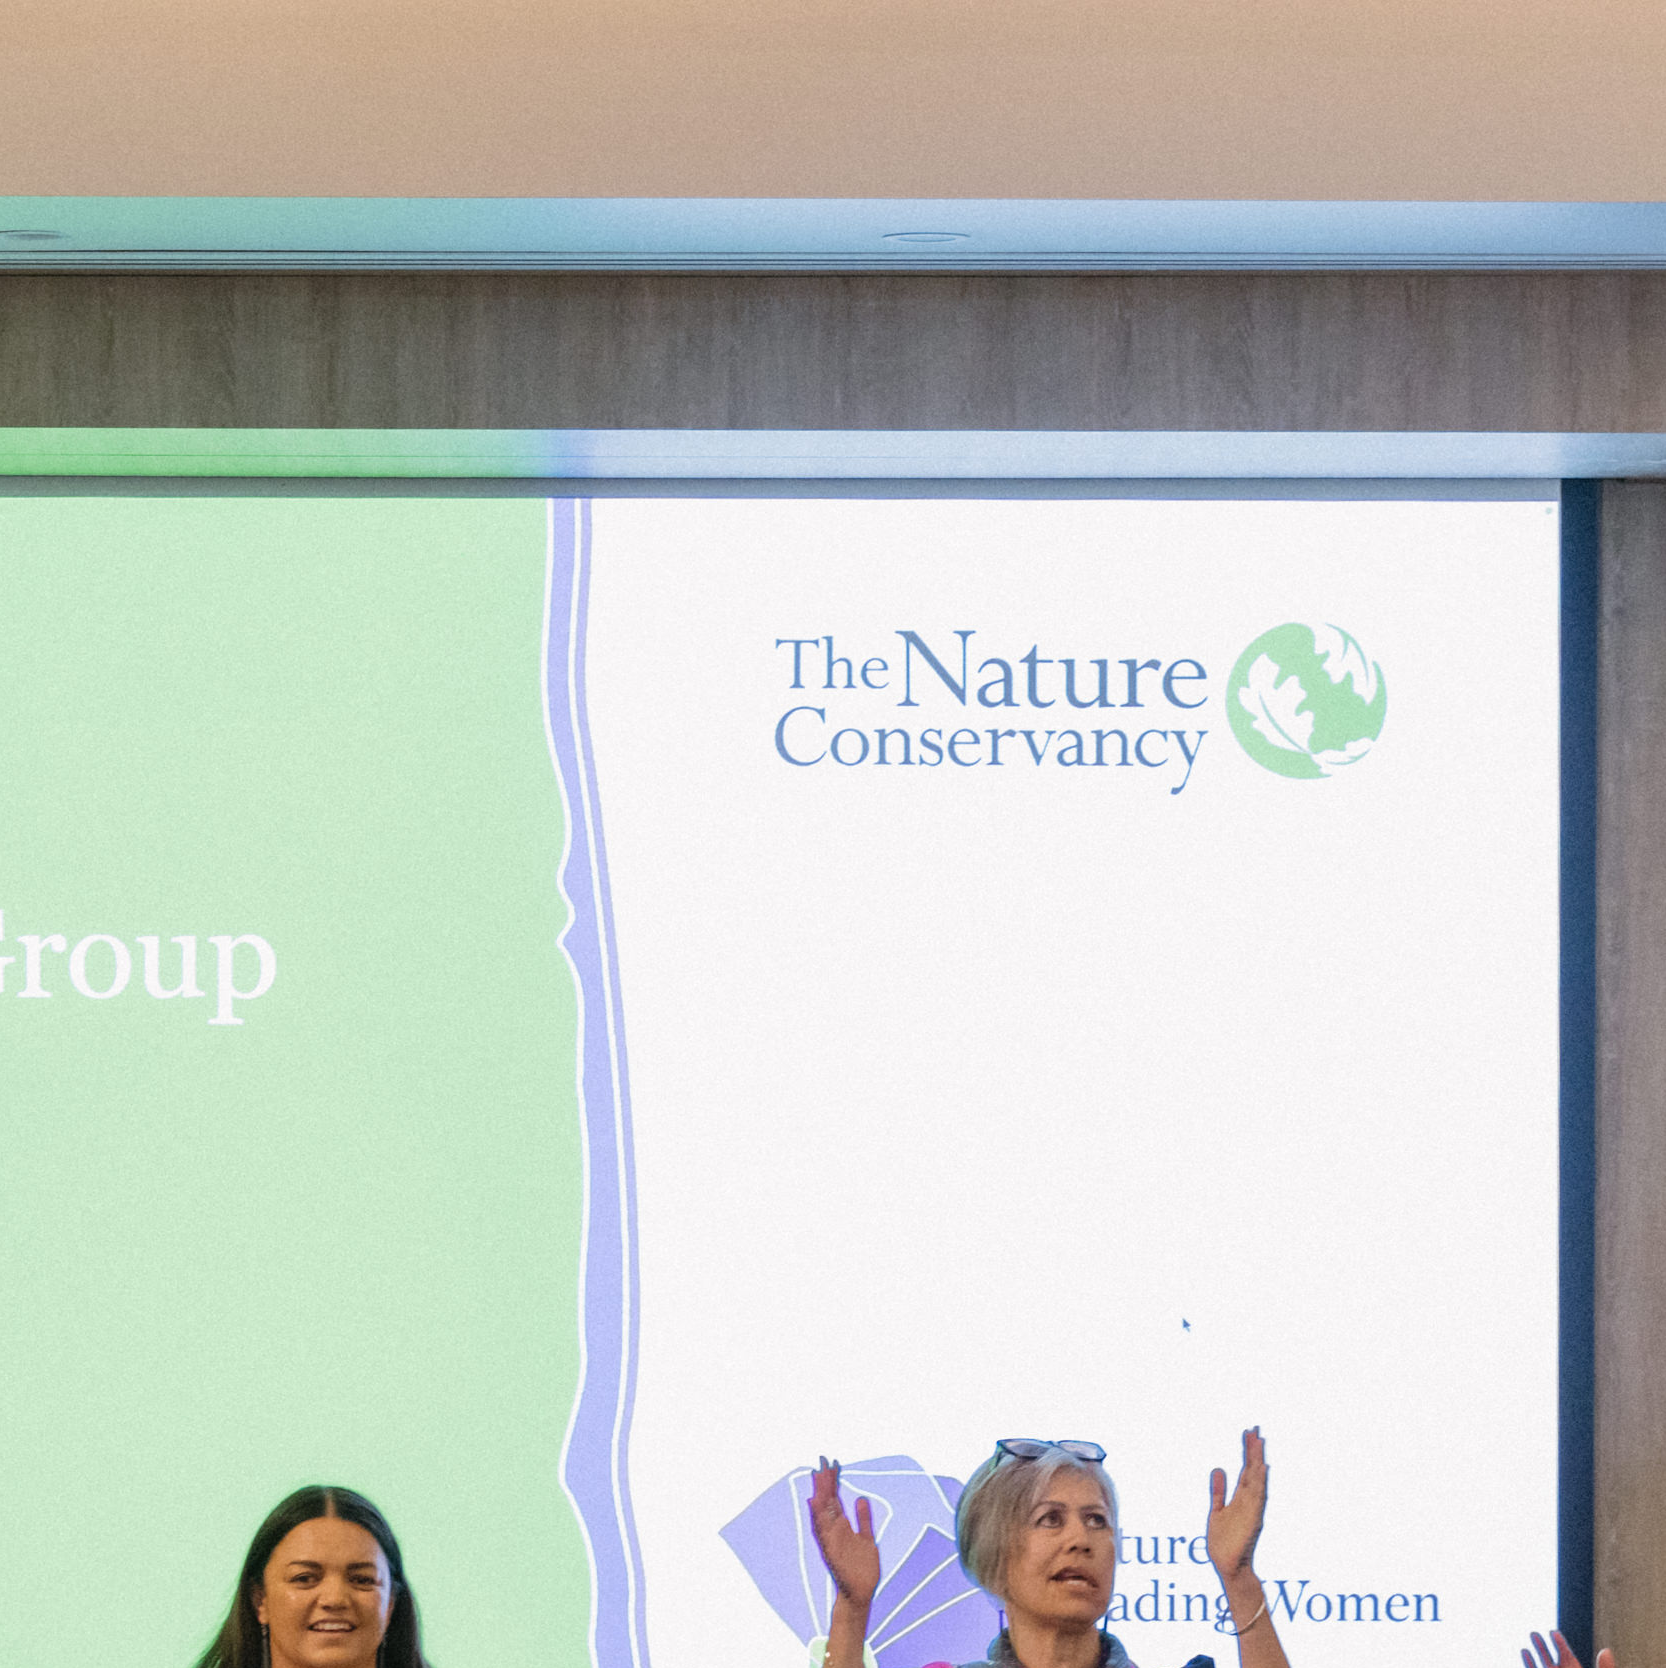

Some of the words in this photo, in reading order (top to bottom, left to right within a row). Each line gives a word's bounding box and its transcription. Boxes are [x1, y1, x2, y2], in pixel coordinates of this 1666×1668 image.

[775, 635, 890, 690] The
[894, 629, 1209, 709] Nature
[773, 706, 1208, 796] Conservancy
[1116, 1528, 1212, 1565] ture
[1107, 1579, 1237, 1636] ading
[1262, 1579, 1442, 1623] Women
